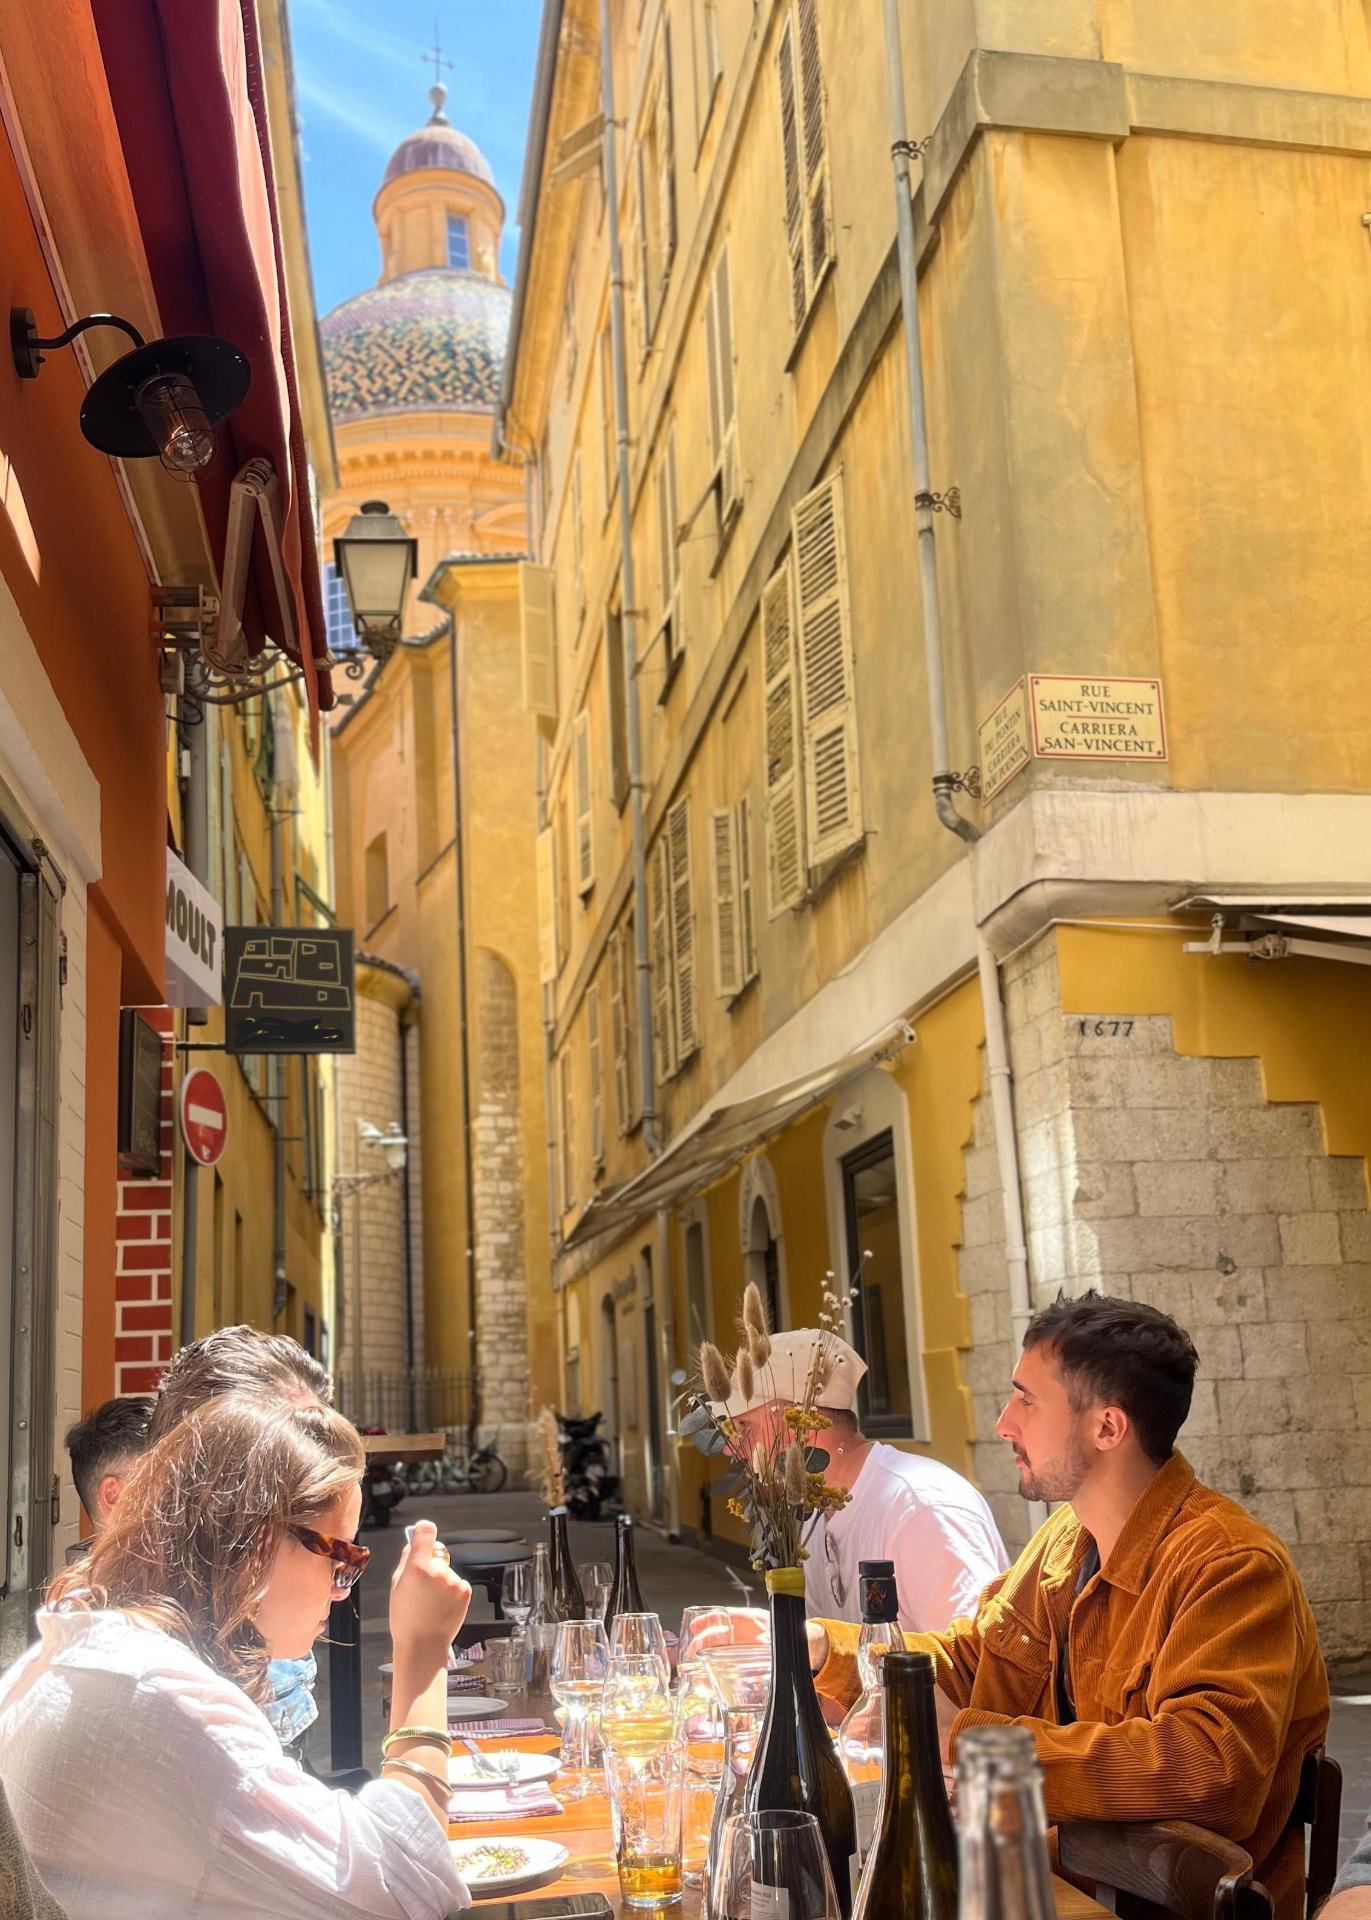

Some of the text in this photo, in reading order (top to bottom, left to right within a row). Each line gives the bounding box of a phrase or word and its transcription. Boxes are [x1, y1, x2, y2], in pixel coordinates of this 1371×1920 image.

[1080, 685, 1111, 698] RUE
[1039, 700, 1154, 715] SAINT-VINCENT
[994, 706, 1008, 728] RUE
[1060, 722, 1138, 737] CARRIERA
[1044, 737, 1155, 753] SAN-VINCENT
[988, 734, 1021, 774] CARRIERA
[1080, 1021, 1134, 1037] 1677
